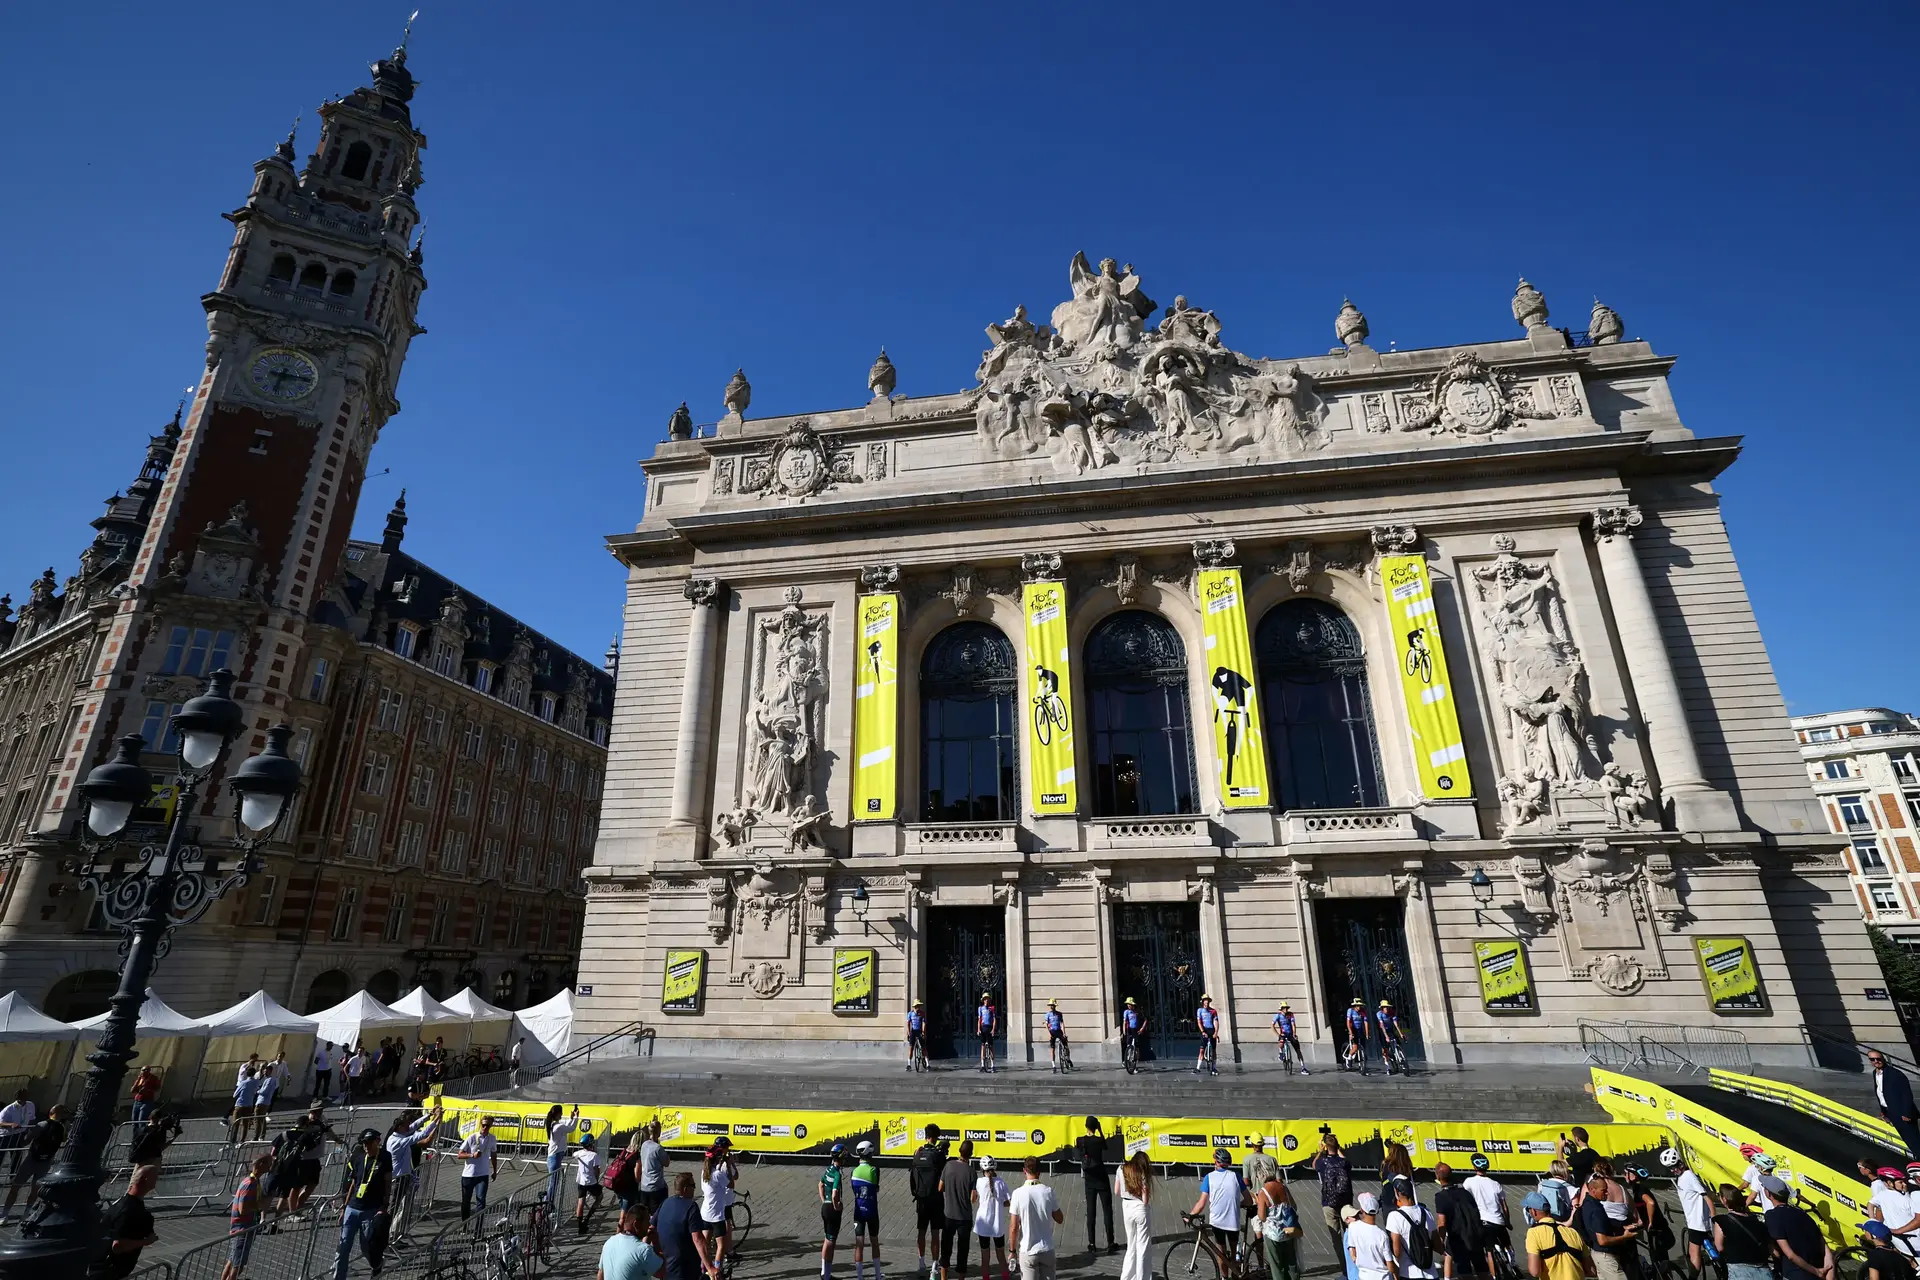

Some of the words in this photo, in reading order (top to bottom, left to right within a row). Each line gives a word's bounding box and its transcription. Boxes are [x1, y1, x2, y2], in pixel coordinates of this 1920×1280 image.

[1389, 573, 1419, 586] france
[1206, 586, 1234, 600] france
[1030, 599, 1058, 611] france
[864, 611, 890, 622] france
[1042, 794, 1065, 802] Nord
[526, 1119, 545, 1127] Nord
[661, 1120, 681, 1130] france
[734, 1125, 756, 1133] Nord
[885, 1125, 907, 1136] france
[966, 1131, 989, 1139] Nord
[1125, 1130, 1148, 1141] france
[1213, 1136, 1238, 1145] Nord
[1483, 1141, 1511, 1150] Nord
[1836, 1192, 1855, 1208] Nord
